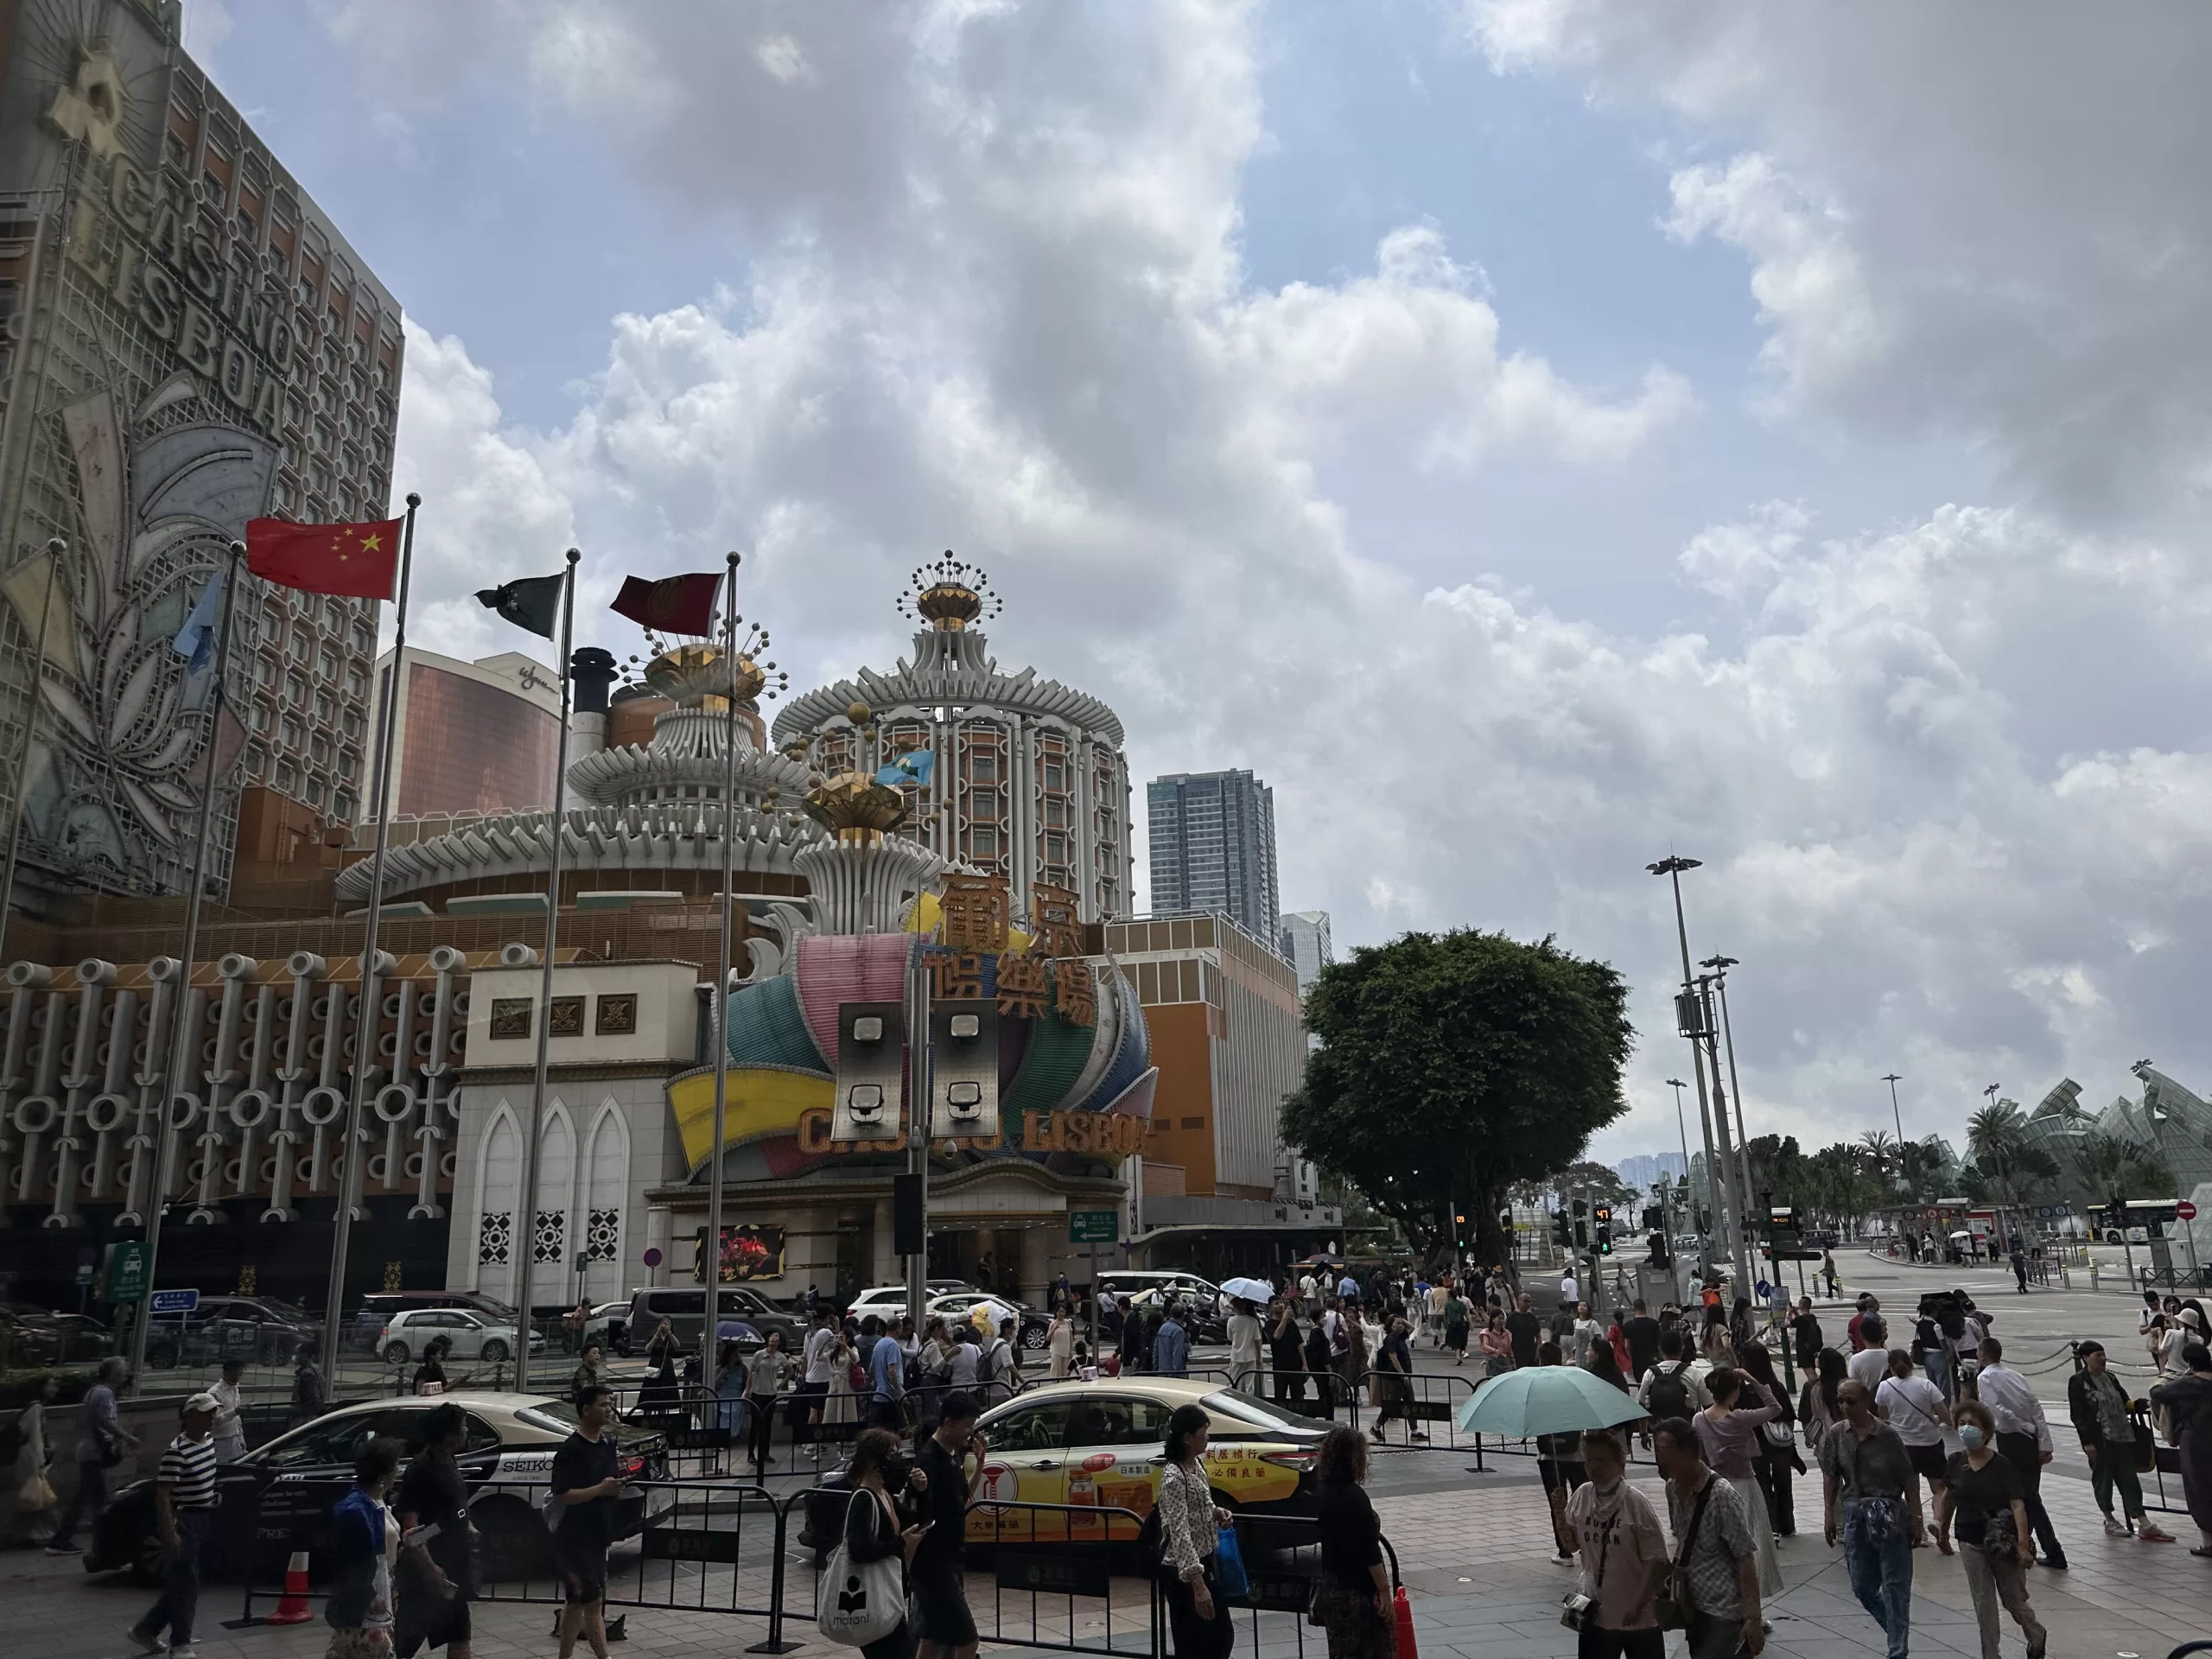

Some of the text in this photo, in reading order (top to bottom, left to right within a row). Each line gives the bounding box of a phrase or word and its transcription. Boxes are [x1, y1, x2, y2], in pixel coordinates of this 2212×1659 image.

[108, 152, 297, 375] CASINO
[68, 194, 286, 445] LISBOA
[1022, 1109, 1152, 1156] LISBOA
[1596, 1210, 1609, 1219] 47
[503, 1459, 555, 1472] SEIKO
[1120, 1466, 1151, 1475] 日本製造
[833, 1612, 870, 1625] marant
